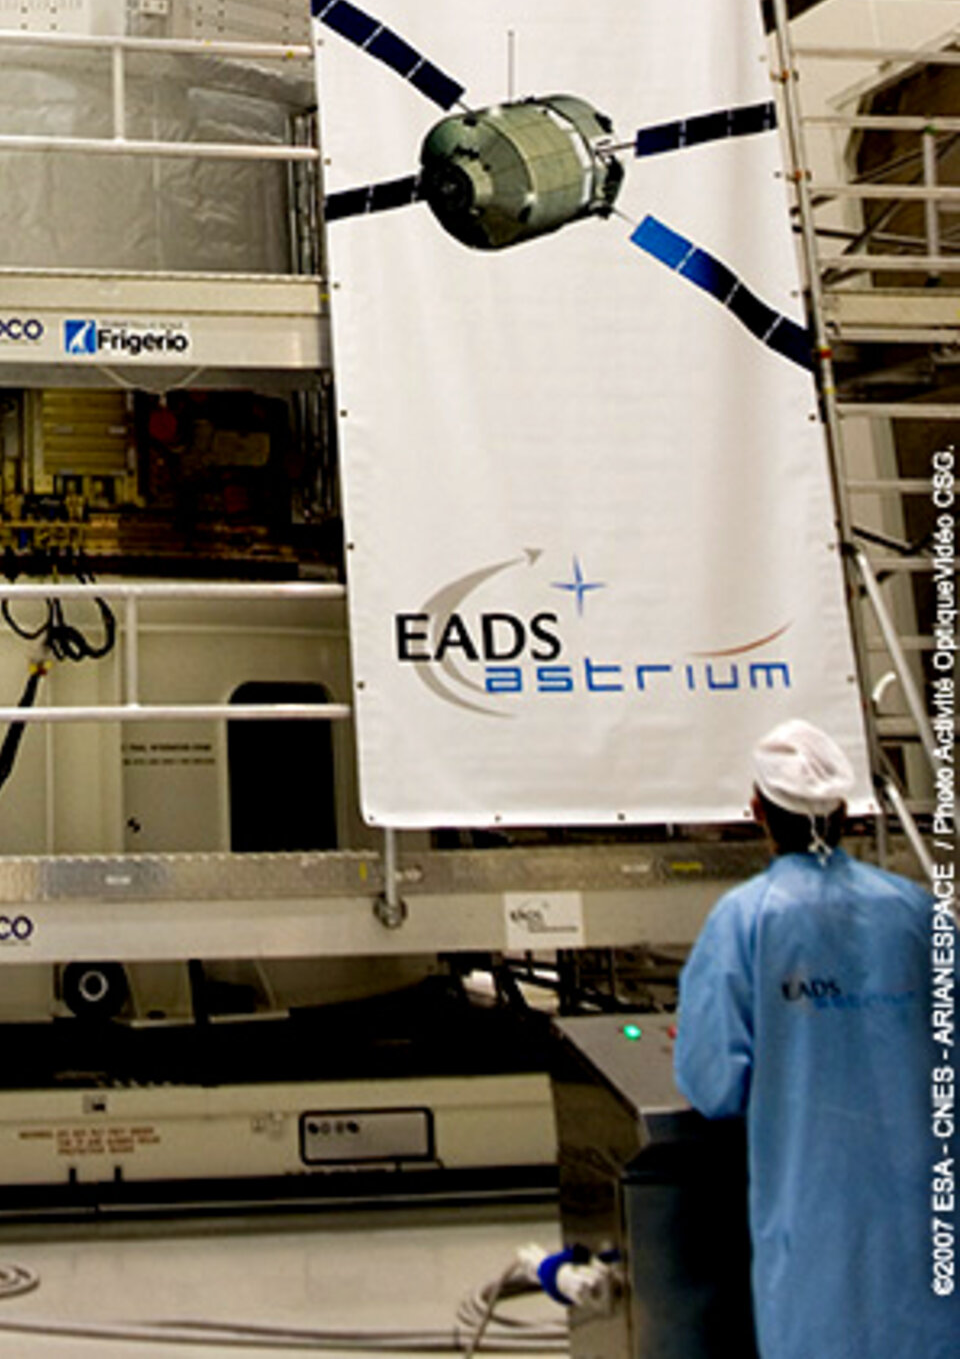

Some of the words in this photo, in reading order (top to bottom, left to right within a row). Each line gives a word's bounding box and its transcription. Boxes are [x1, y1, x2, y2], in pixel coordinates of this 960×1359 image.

[97, 329, 188, 355] Frigerio
[395, 613, 562, 663] EADS
[484, 657, 792, 693] astrium
